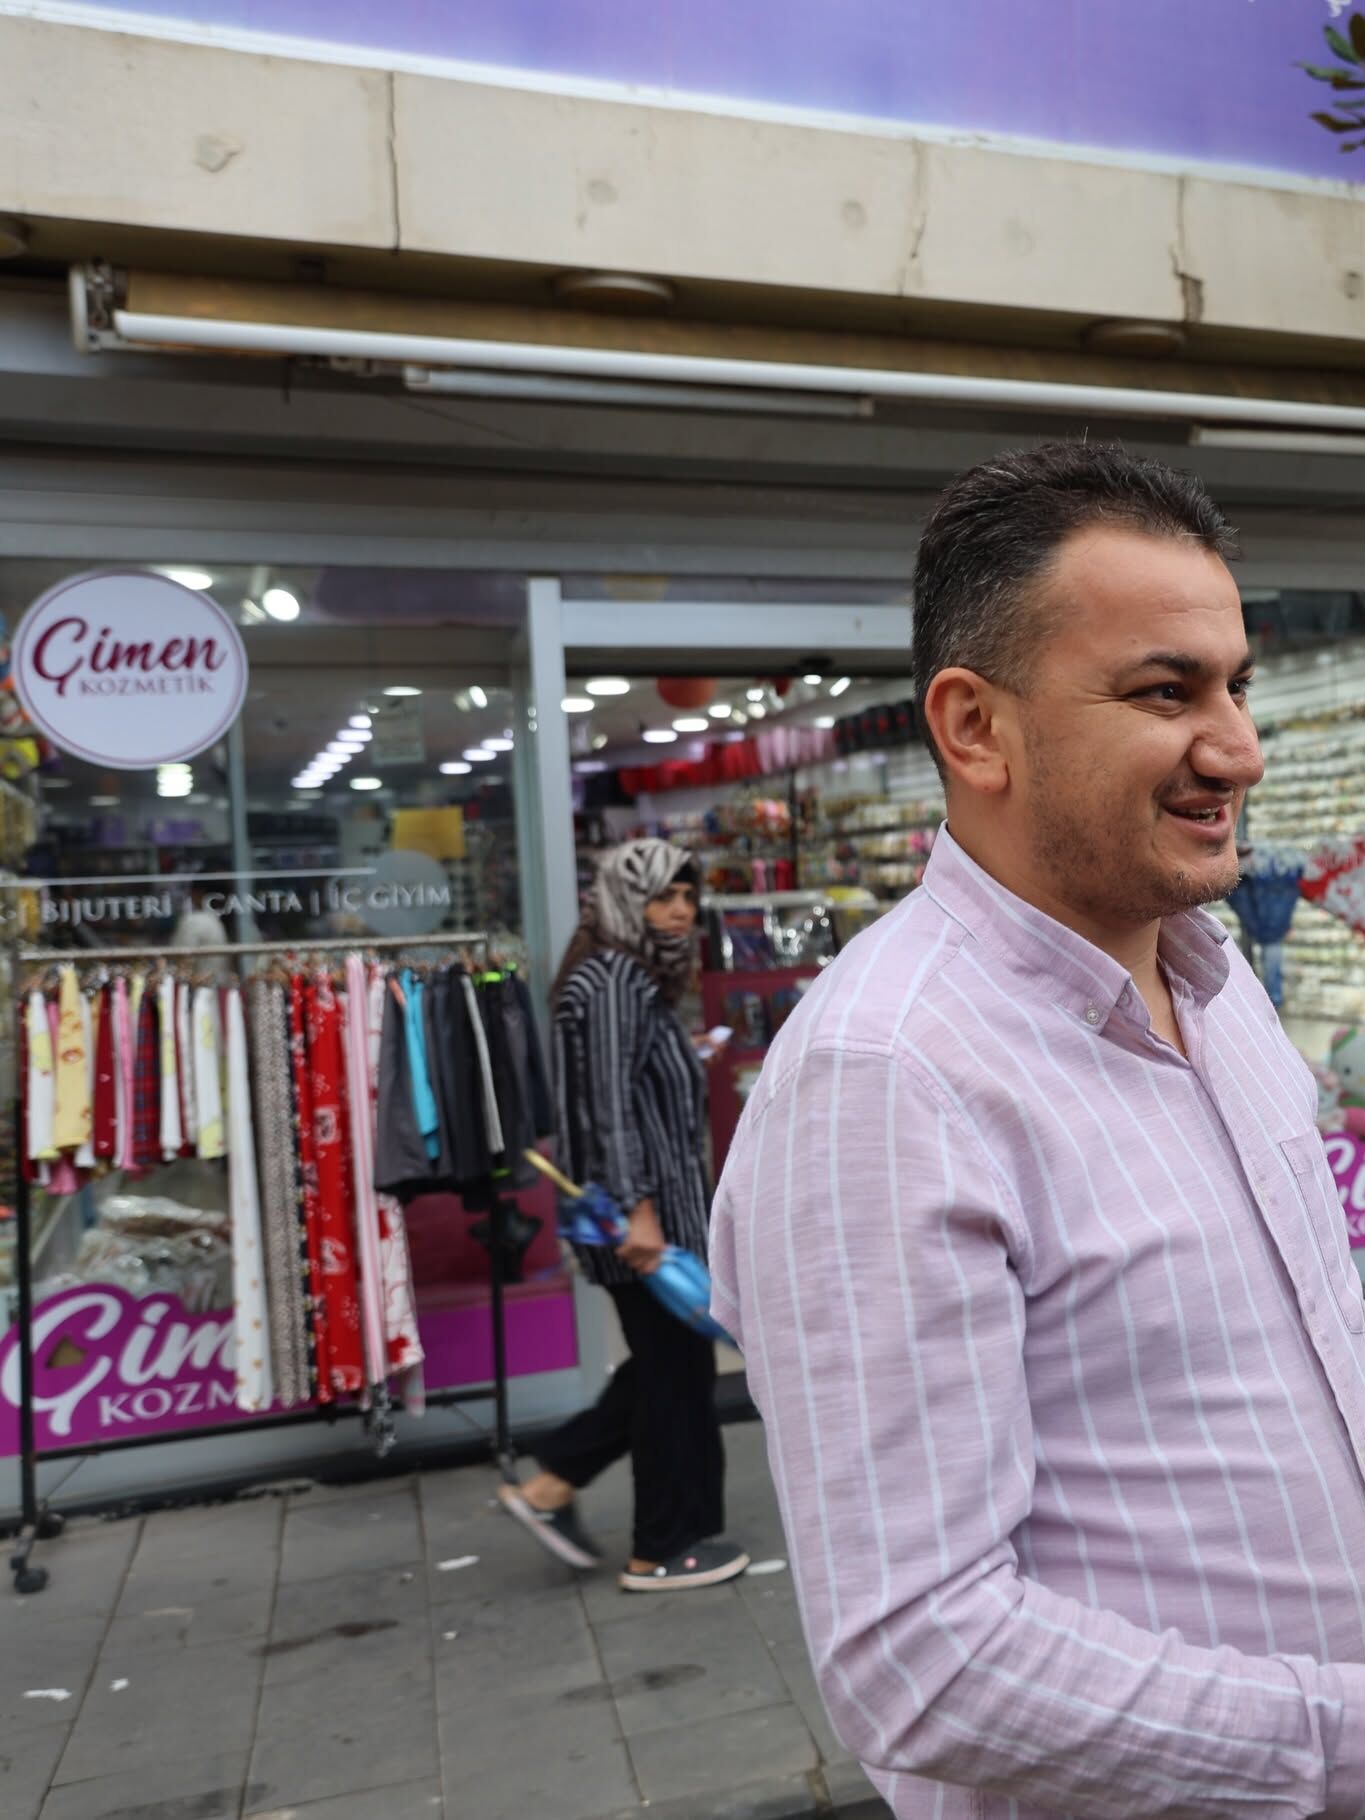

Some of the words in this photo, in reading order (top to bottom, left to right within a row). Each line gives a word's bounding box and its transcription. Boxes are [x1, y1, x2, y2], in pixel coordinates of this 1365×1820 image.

[32, 616, 228, 697] Çimen
[1, 1292, 237, 1437] Çim
[99, 1378, 238, 1427] KOZM
